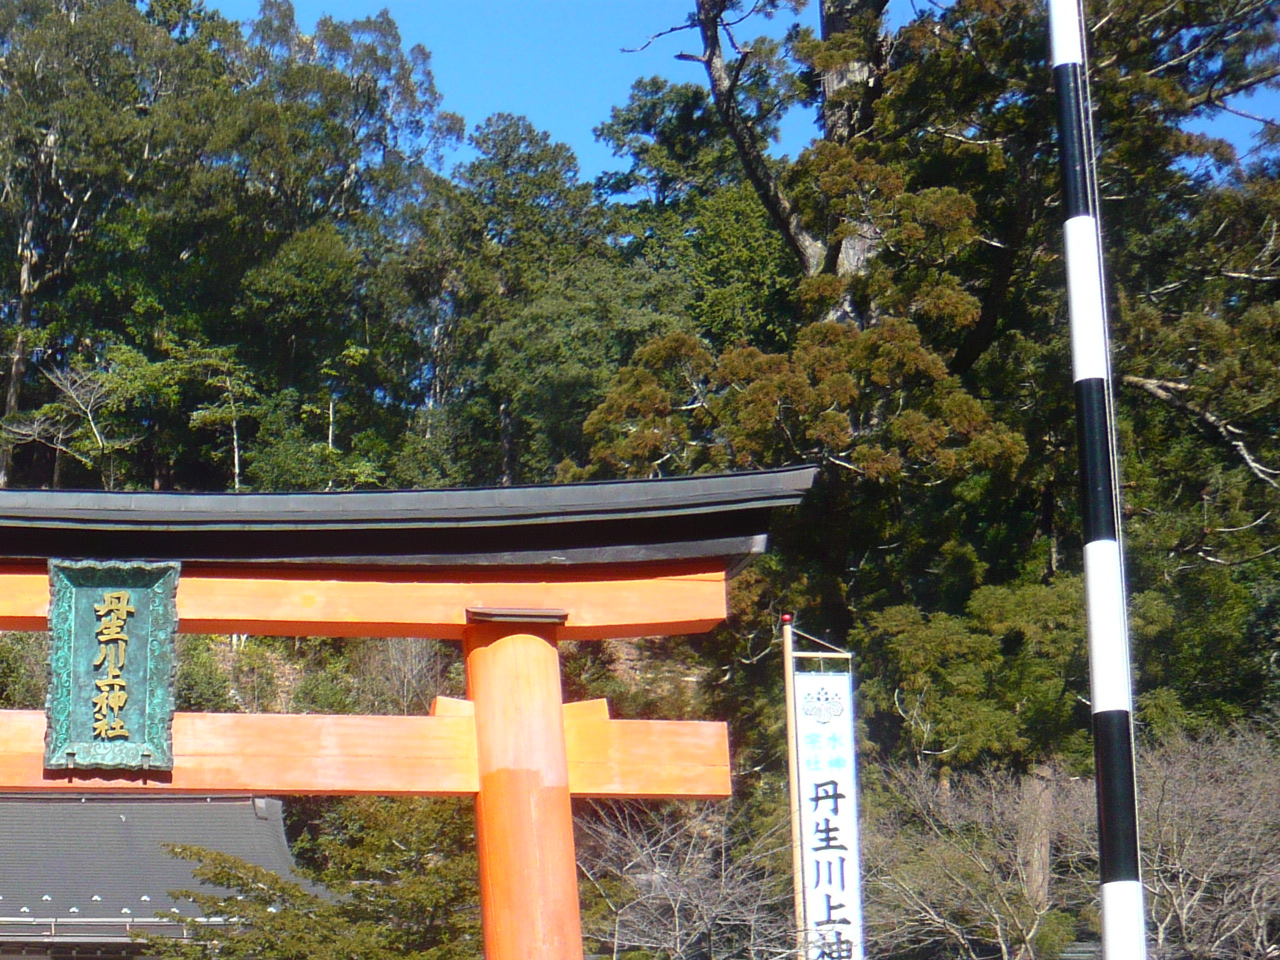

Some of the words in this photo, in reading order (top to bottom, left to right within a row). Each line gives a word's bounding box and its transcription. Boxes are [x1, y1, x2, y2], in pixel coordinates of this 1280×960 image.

[94, 590, 135, 739] 丹生川上神社
